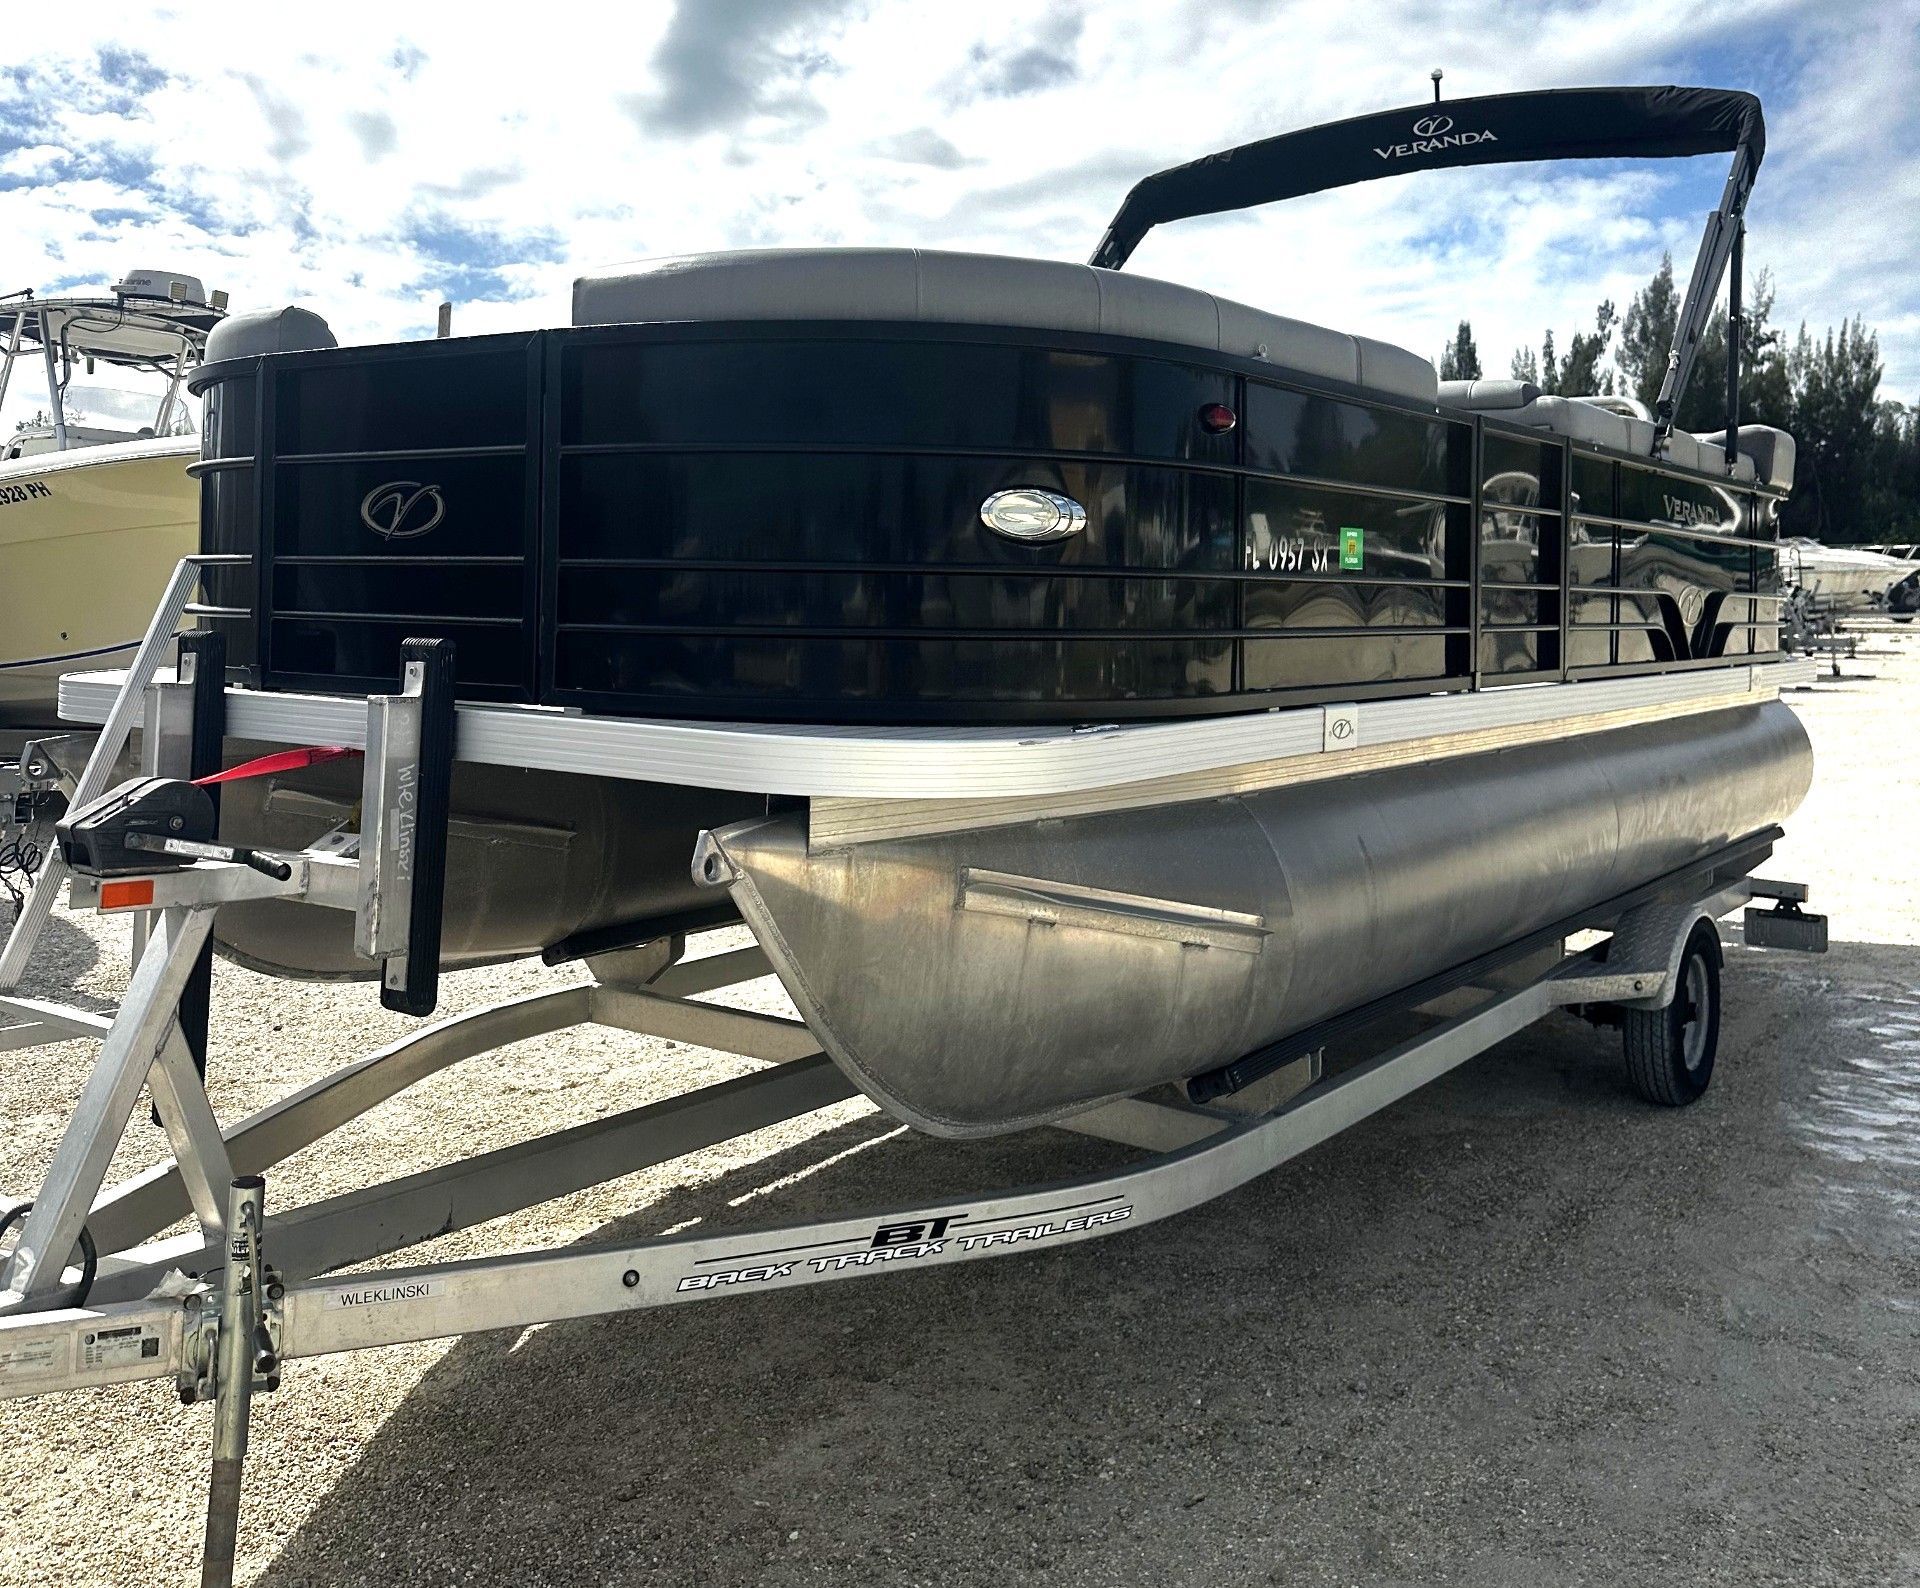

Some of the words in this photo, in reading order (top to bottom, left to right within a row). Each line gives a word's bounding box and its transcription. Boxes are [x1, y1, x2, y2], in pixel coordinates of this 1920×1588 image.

[1373, 129, 1499, 160] VERANDA
[25, 481, 53, 499] PH
[1663, 494, 1721, 526] VERANDA
[1244, 531, 1260, 571] FL
[1269, 535, 1305, 571] 0957
[1312, 537, 1329, 572] SX
[870, 1213, 968, 1248] BT
[676, 1260, 803, 1292] BACK
[807, 1237, 953, 1273] TRACK
[956, 1204, 1134, 1251] TRAILERS
[341, 1283, 430, 1307] WLEKLINSKI
